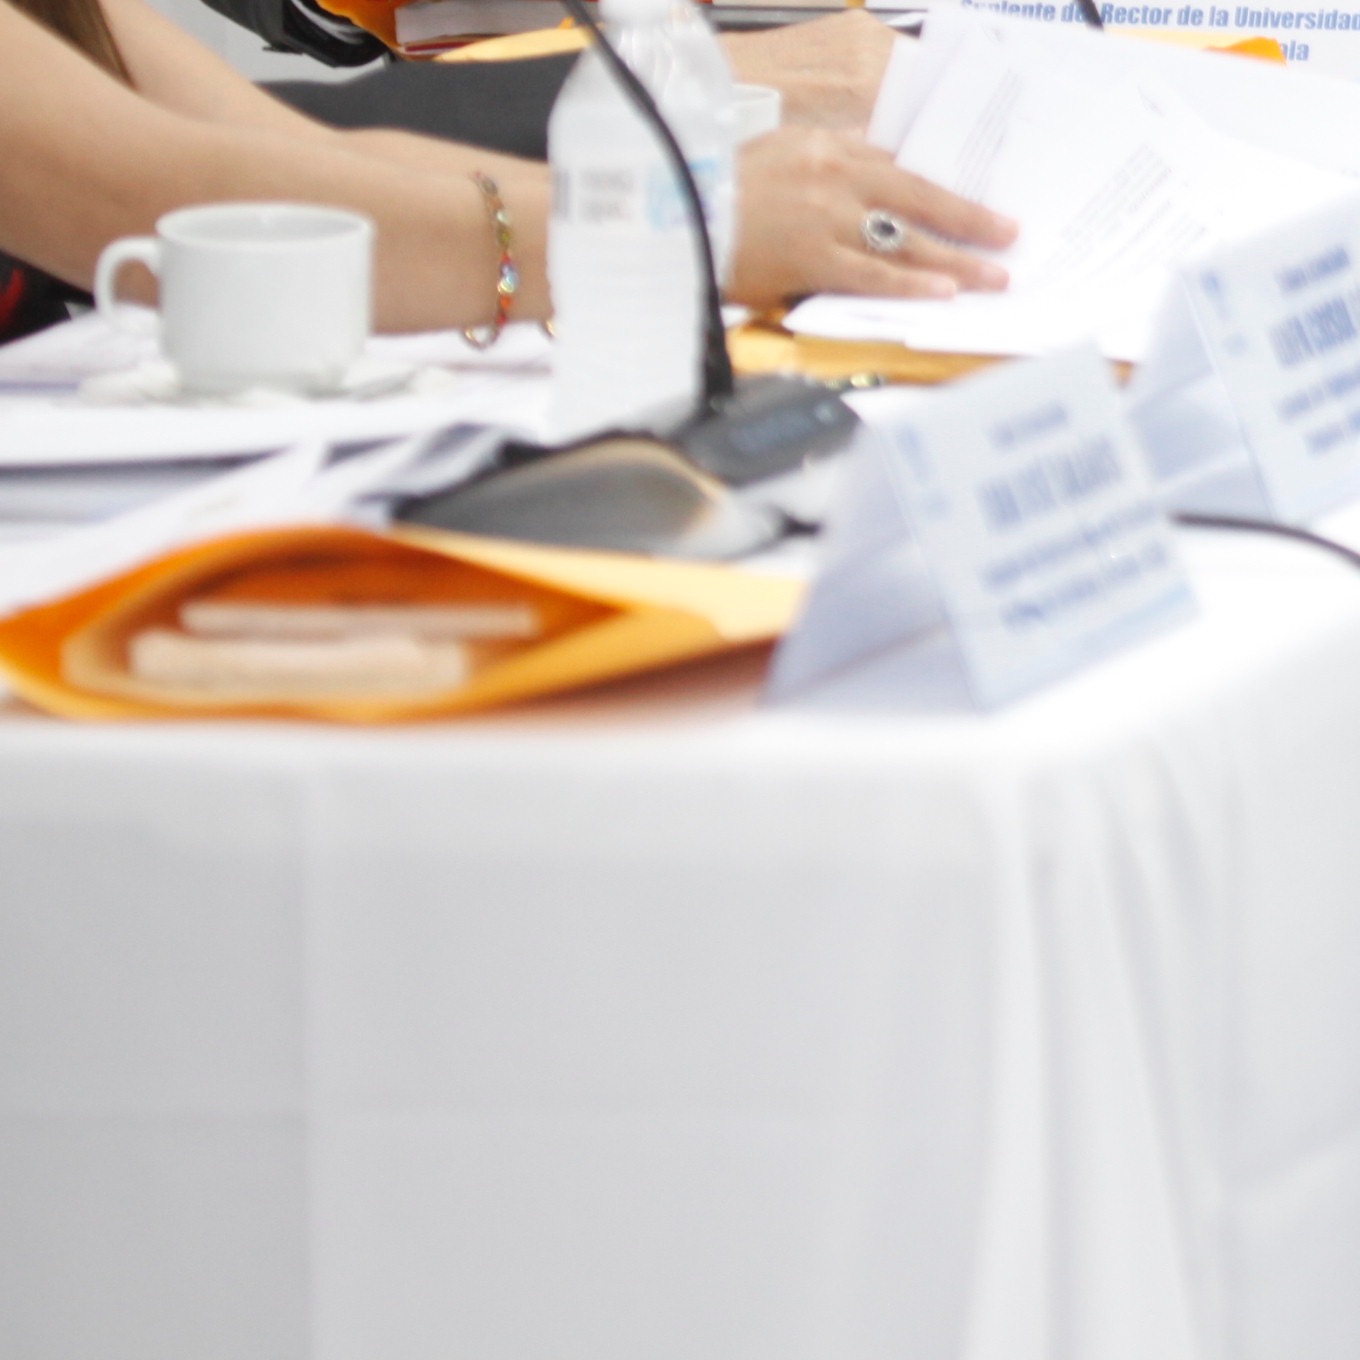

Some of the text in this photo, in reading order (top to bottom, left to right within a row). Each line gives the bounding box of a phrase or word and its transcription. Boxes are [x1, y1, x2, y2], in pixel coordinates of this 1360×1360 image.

[1100, 2, 1172, 26] Rector
[1176, 5, 1204, 27] de
[1208, 5, 1229, 28] la
